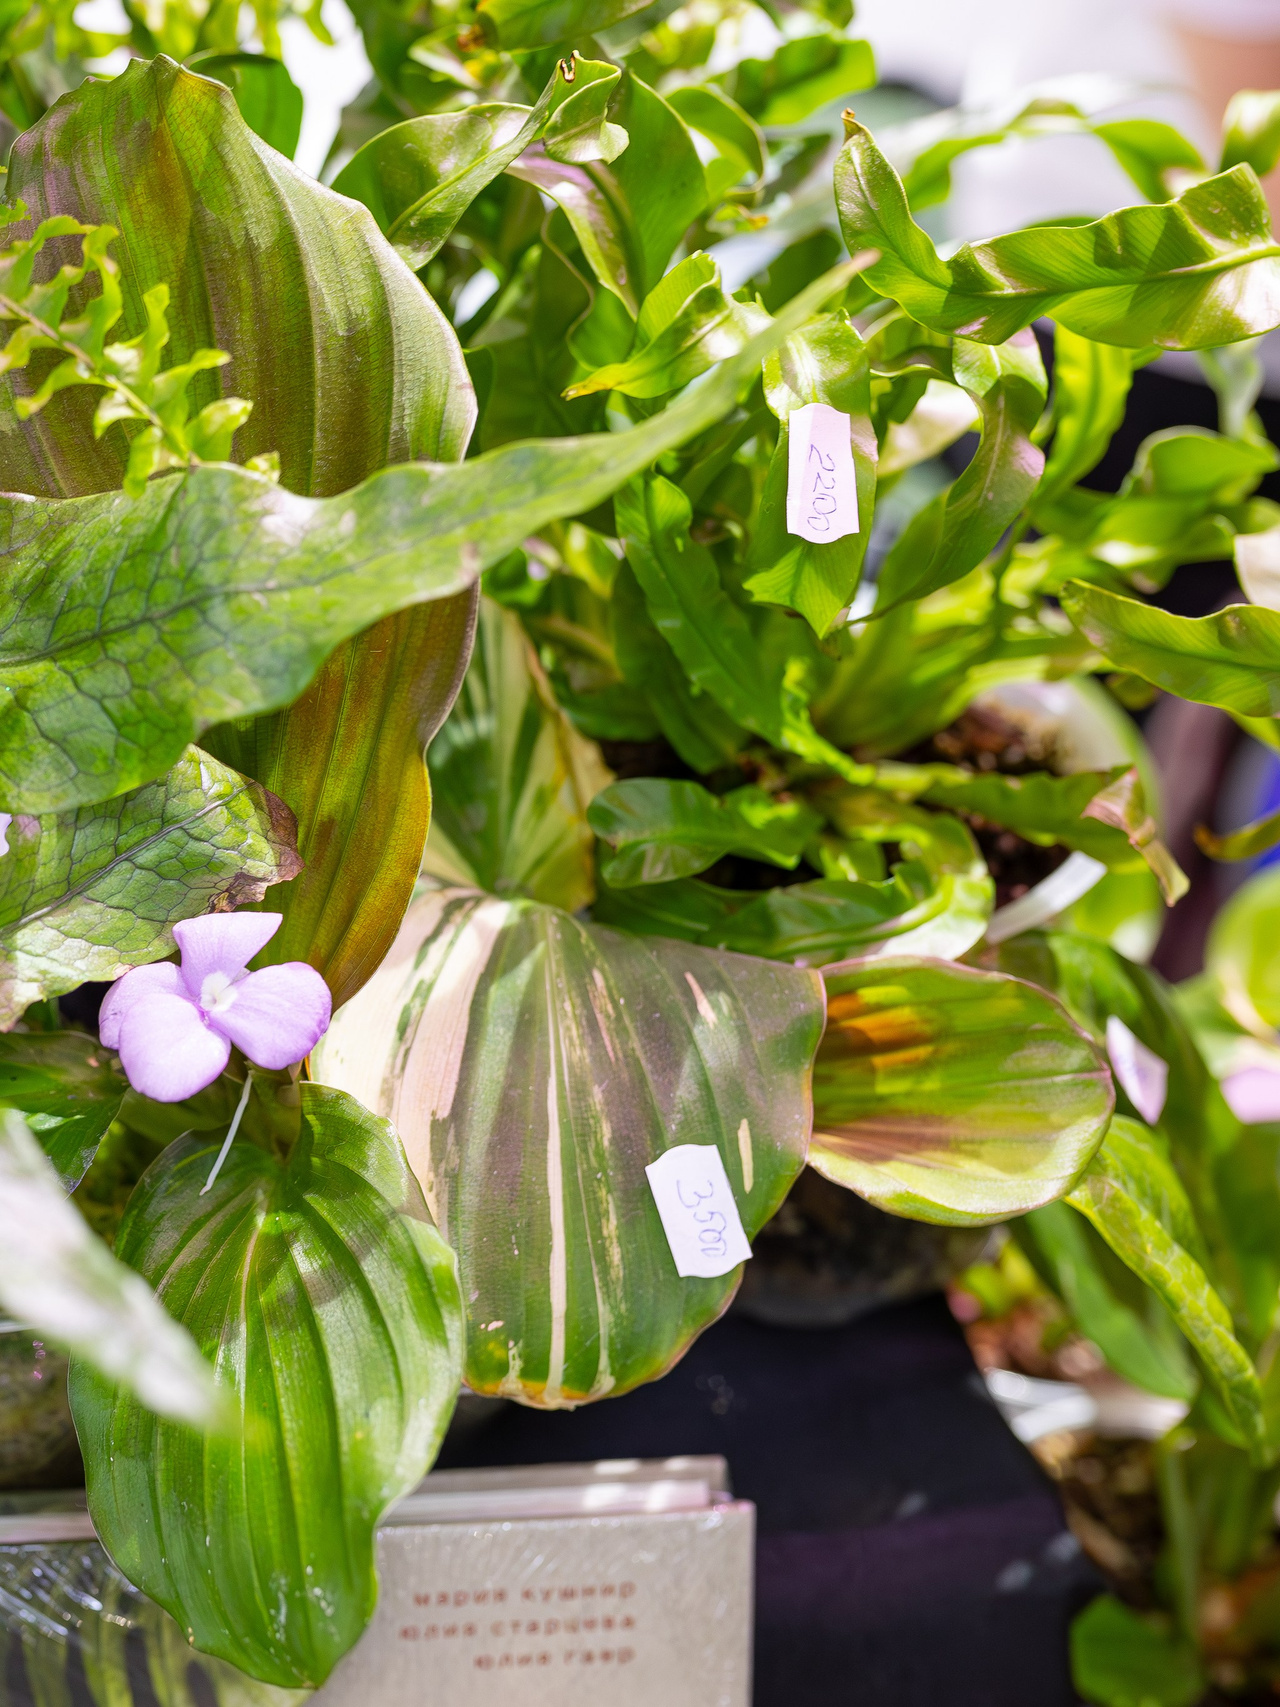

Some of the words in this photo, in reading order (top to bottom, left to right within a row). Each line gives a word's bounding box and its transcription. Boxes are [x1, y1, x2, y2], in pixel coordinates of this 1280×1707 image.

[806, 443, 838, 532] 2200
[676, 1179, 728, 1258] 3500
[412, 1588, 508, 1607] мария
[521, 1581, 637, 1603] кушнир
